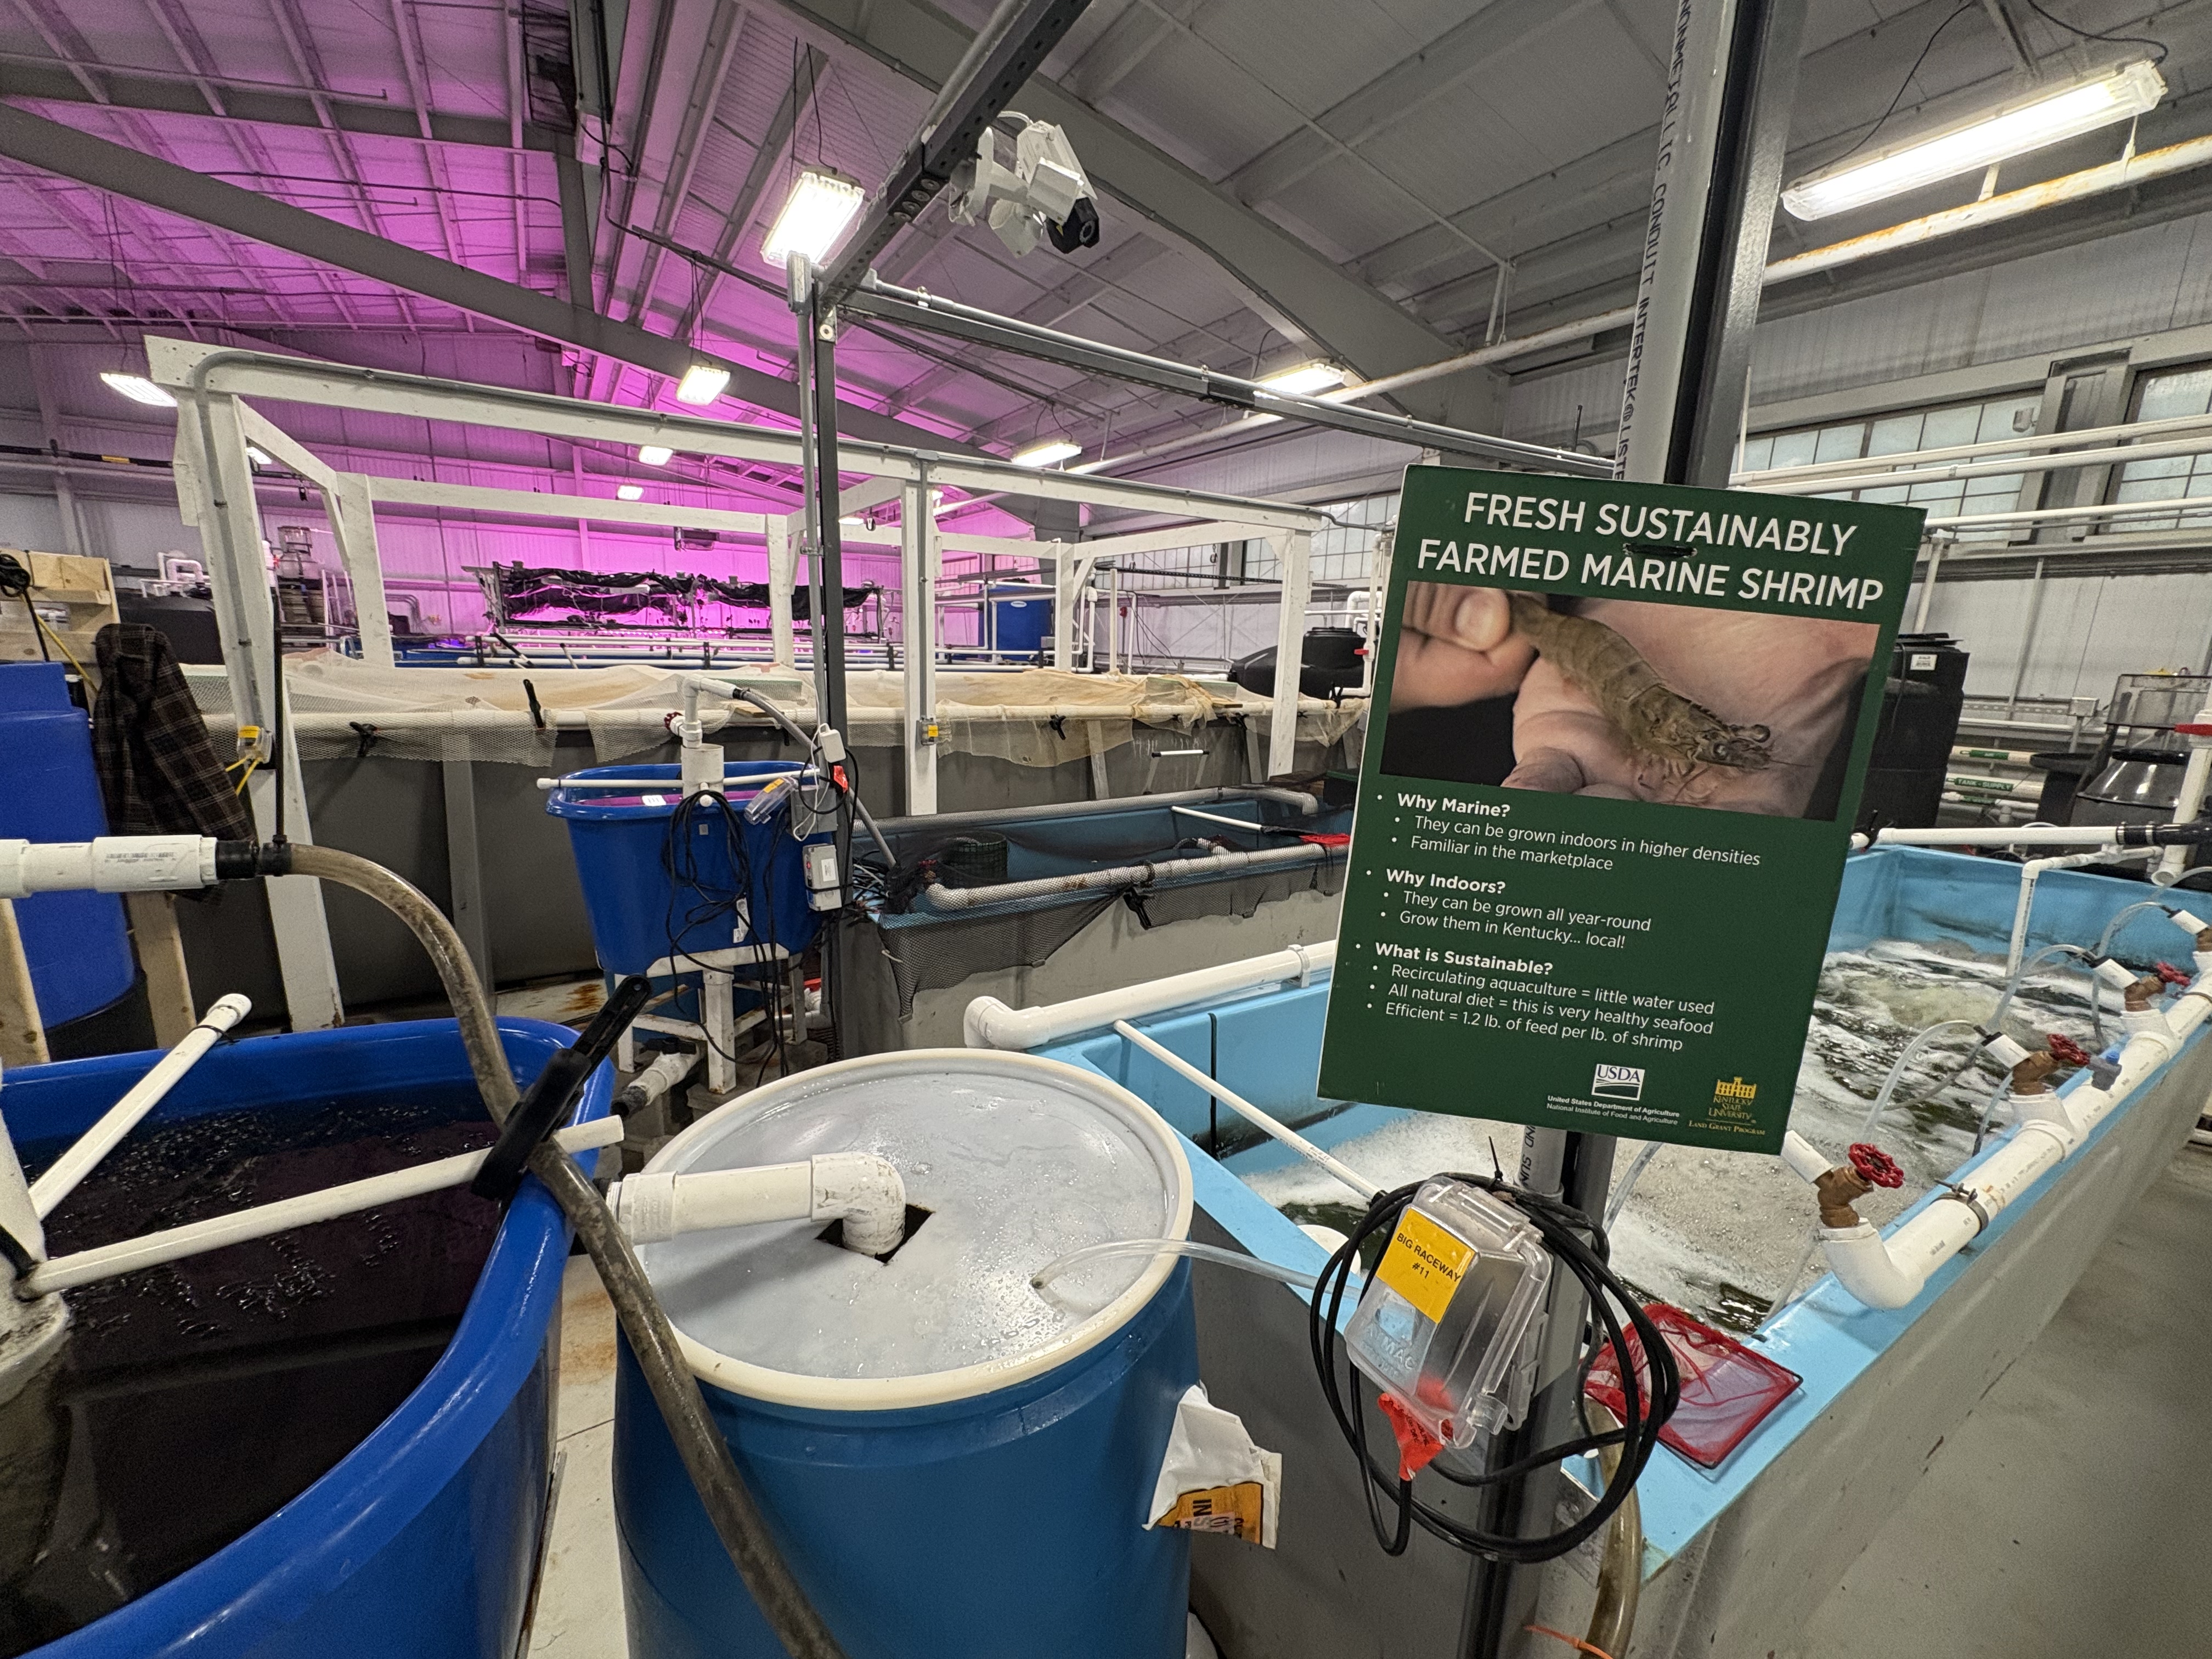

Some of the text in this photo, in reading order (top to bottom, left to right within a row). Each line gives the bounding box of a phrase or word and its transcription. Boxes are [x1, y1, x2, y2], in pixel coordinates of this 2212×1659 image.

[1641, 183, 1667, 286] CONDUIT
[1624, 296, 1650, 405] INTERTEK
[1464, 491, 1858, 556] FRESH SUSTAINABLY
[1417, 538, 1883, 610] FARMED MARINE SHRIMP
[1397, 792, 1510, 817] Why Marine?
[1410, 835, 1613, 870] Familiar in the marketplace
[1414, 815, 1760, 865] They can be grown indoors in higher densities
[1386, 868, 1506, 894] Why Indoors?
[1403, 890, 1651, 931] They can be grown all year-round
[1400, 910, 1626, 949] Grow them in Kentucky... local!
[1375, 941, 1553, 975] What is Sustainable?
[1391, 963, 1486, 989] Recirculating
[1489, 978, 1577, 998] aquaculture
[1594, 988, 1628, 1004] little
[1632, 995, 1675, 1009] water
[1678, 1001, 1714, 1014] used
[1387, 983, 1408, 997] All
[1411, 988, 1462, 1004] natural
[1465, 992, 1495, 1008] diet
[1512, 998, 1538, 1013] this
[1542, 1001, 1554, 1015] is
[1559, 1006, 1591, 1022] very
[1594, 1007, 1650, 1029] healthy
[1652, 1017, 1713, 1034] seafood
[1385, 1001, 1445, 1021] Efficient
[1463, 1011, 1481, 1025] 1.2
[1484, 1013, 1501, 1028] lb.
[1505, 1017, 1522, 1030] of
[1525, 1018, 1558, 1035] feed
[1561, 1026, 1587, 1039] per
[1590, 1026, 1607, 1041] lb.
[1612, 1030, 1629, 1043] of
[1631, 1032, 1683, 1052] shrimp
[1597, 1065, 1641, 1082] USDA
[1547, 1095, 1570, 1103] United
[1571, 1098, 1592, 1106] States
[1594, 1101, 1633, 1111] Department
[1642, 1107, 1680, 1118] Agriculture
[1547, 1103, 1574, 1111] National
[1575, 1107, 1601, 1115] Institute
[1642, 1115, 1678, 1125] Agriculture
[1708, 1107, 1752, 1120] UNIVERSITY
[1713, 1095, 1754, 1105] KENTUCKY
[1525, 1125, 1536, 1148] ND
[1708, 1123, 1733, 1132] GRANT
[1396, 1232, 1461, 1283] BIG RACEWAY
[1412, 1262, 1430, 1279] #11
